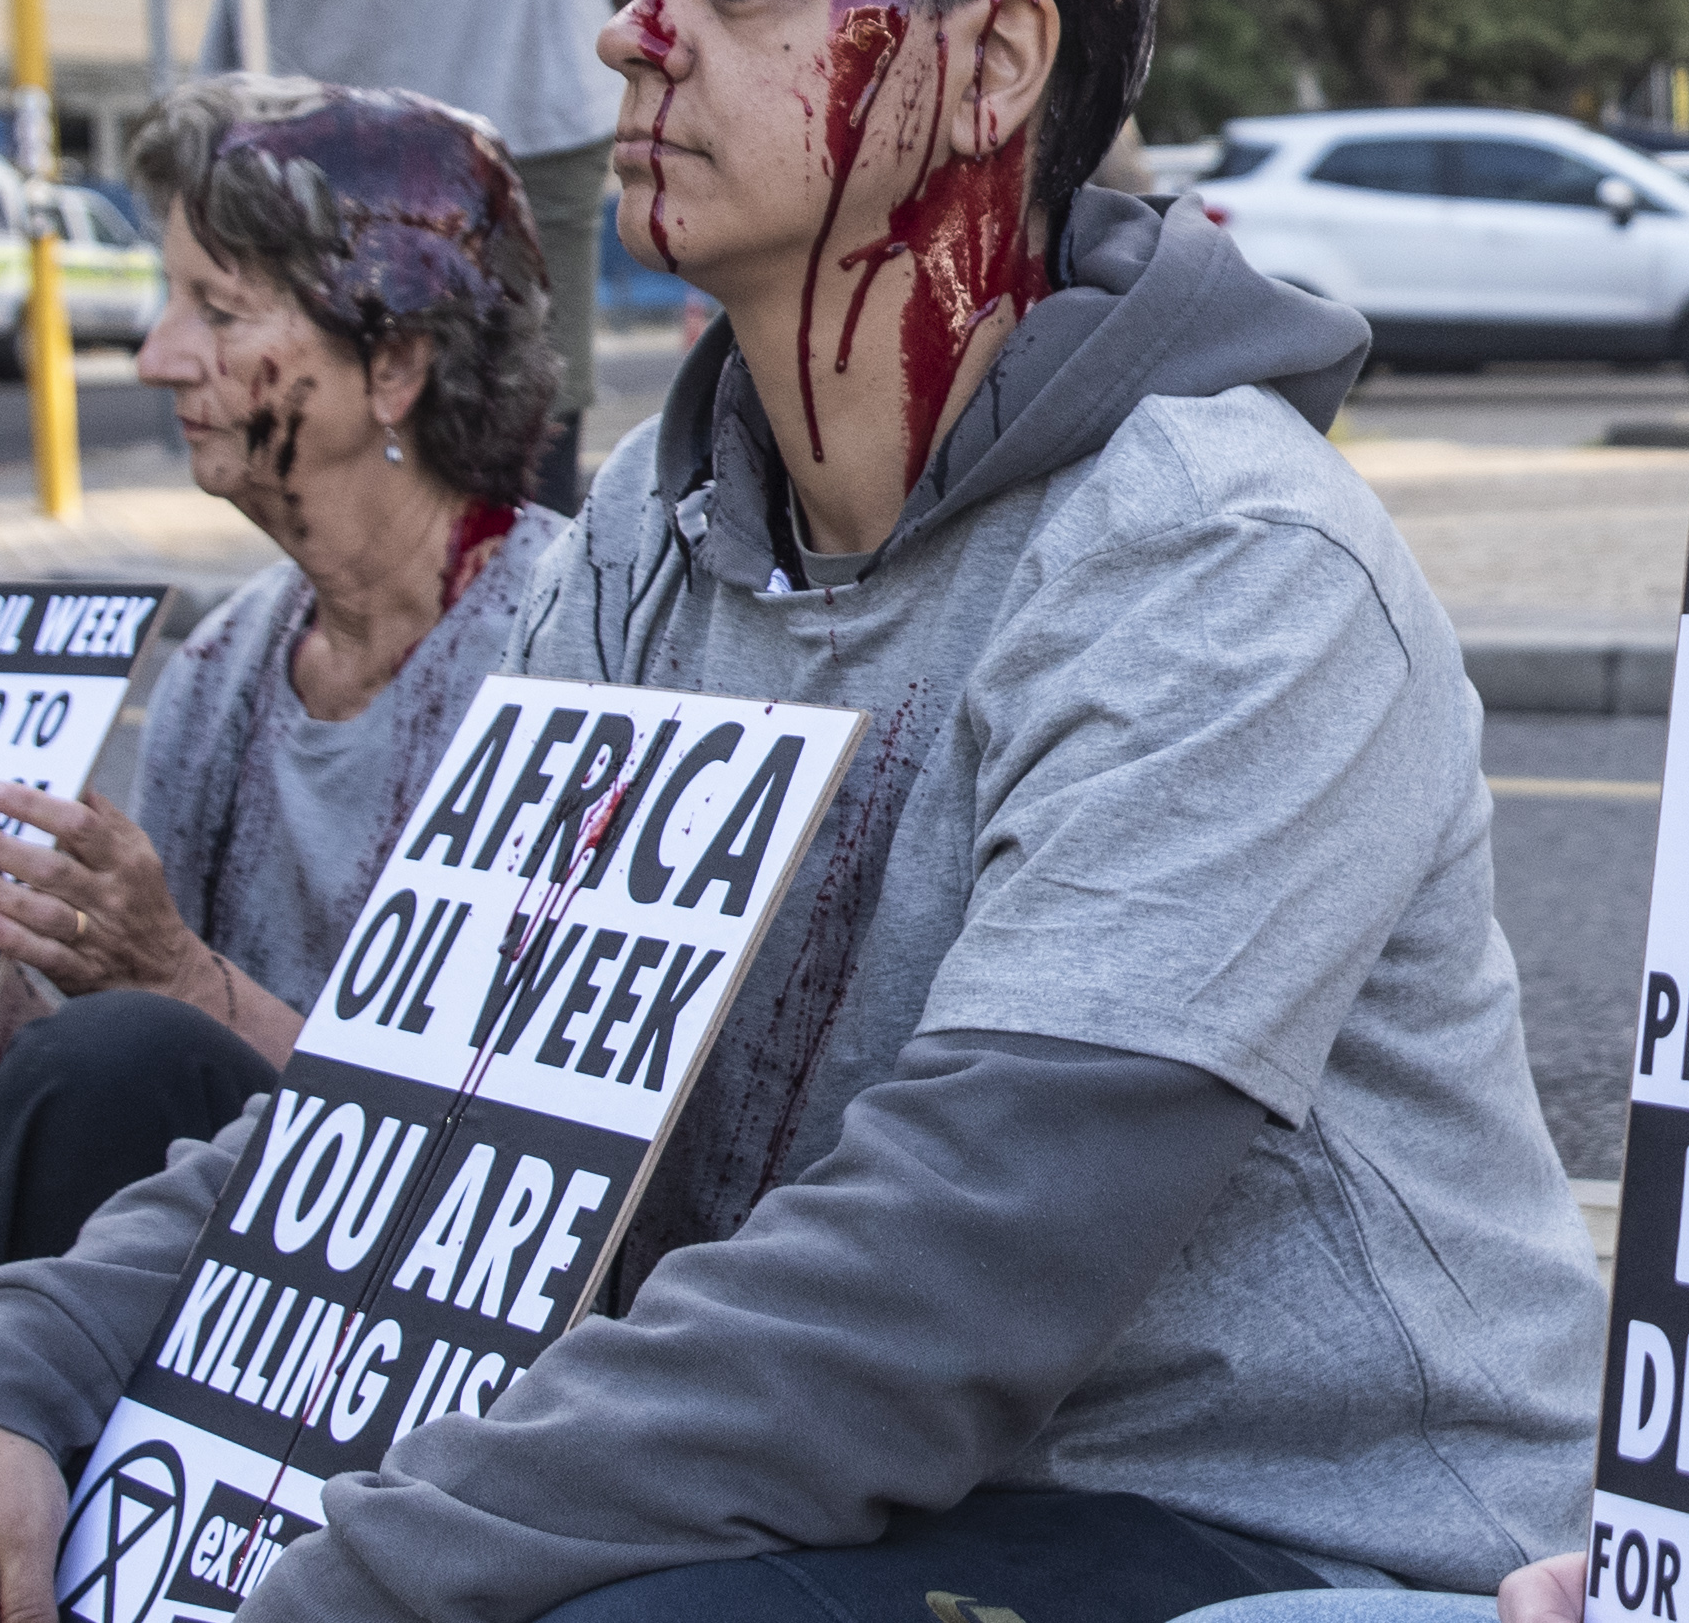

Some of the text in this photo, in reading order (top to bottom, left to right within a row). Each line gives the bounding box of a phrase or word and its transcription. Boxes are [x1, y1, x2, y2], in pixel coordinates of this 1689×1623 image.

[11, 691, 72, 747] TO
[33, 595, 157, 658] WEEK
[405, 702, 806, 918] AFRICA
[335, 888, 726, 1092] OIL WEEK
[229, 1088, 610, 1333] YOU ARE
[155, 1258, 527, 1445] KILLING US
[1589, 1520, 1681, 1623] FOR
